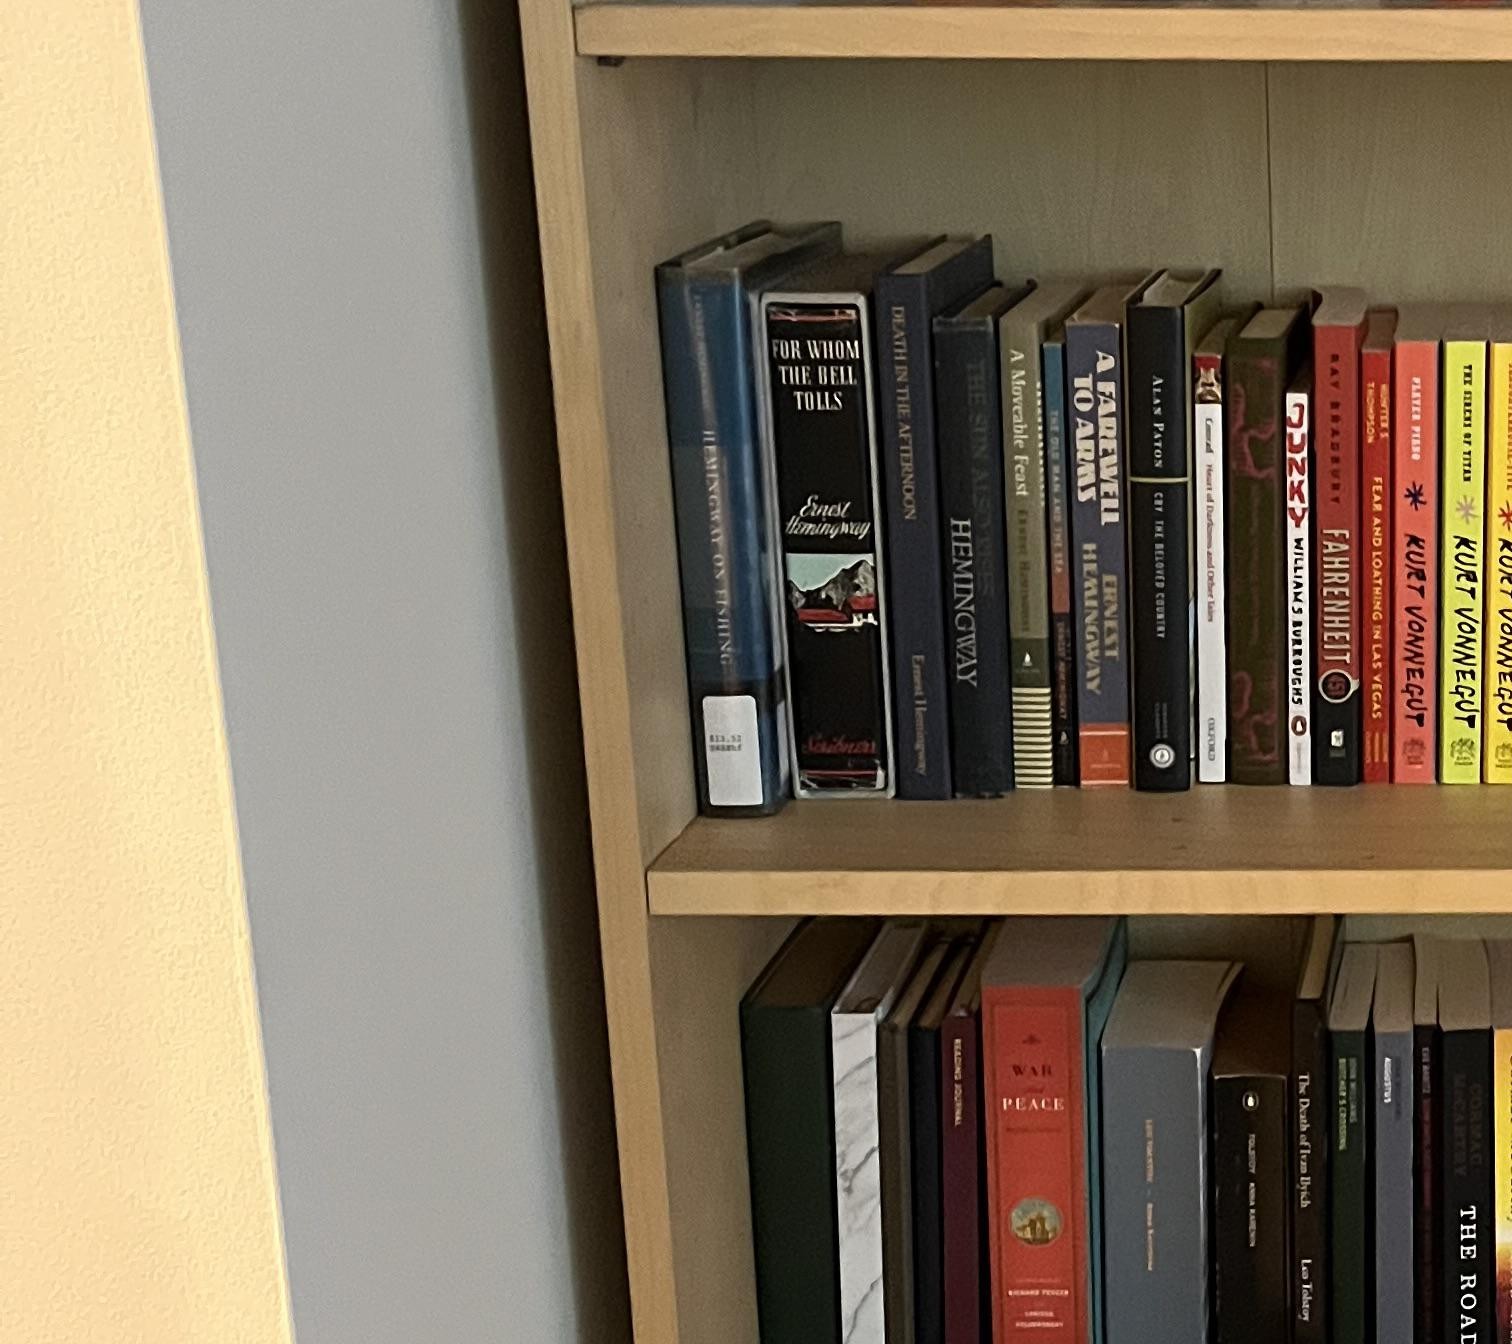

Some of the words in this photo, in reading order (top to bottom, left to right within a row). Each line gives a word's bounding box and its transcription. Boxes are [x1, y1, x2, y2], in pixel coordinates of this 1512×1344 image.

[1074, 373, 1094, 413] TO
[1096, 350, 1115, 372] A
[1076, 417, 1096, 502] ARMS
[1098, 380, 1119, 526] FAREWELL
[1371, 477, 1384, 512] FEAR
[1371, 516, 1384, 547] AND
[1321, 528, 1351, 664] FAHRENHEIT
[1371, 551, 1384, 621] LOATHING
[1405, 533, 1425, 599] KURT
[1454, 534, 1477, 600] KURT
[950, 518, 977, 687] HEMINGWAY
[1371, 643, 1384, 667] LAS
[1403, 606, 1426, 727] VONNEGUT
[1449, 607, 1477, 729] VONNEGUT
[1371, 673, 1384, 719] VEGAS
[1460, 1206, 1476, 1259] THE
